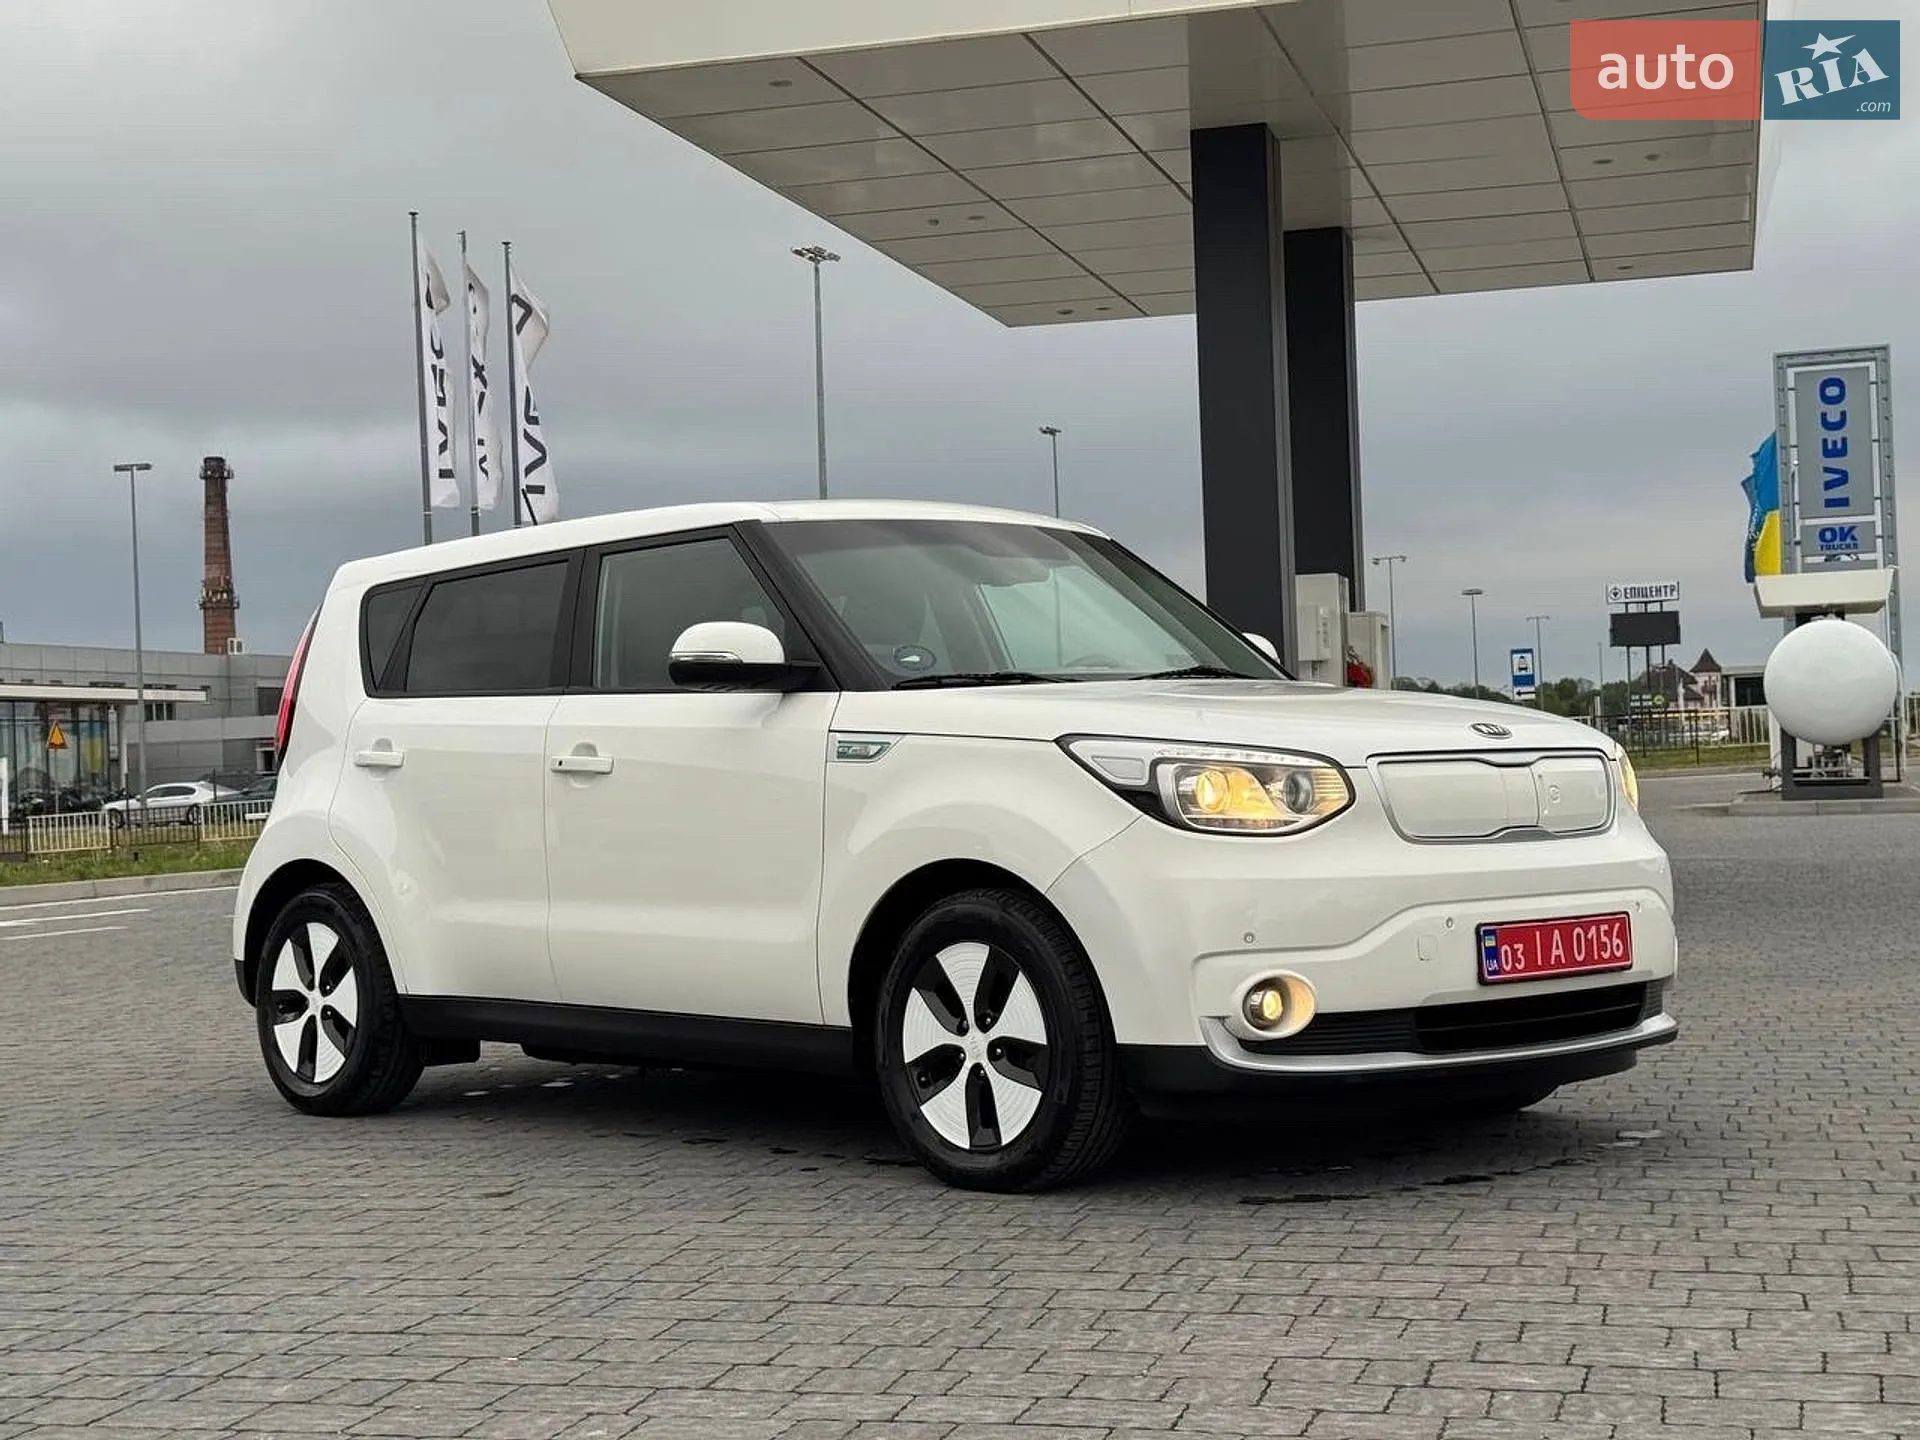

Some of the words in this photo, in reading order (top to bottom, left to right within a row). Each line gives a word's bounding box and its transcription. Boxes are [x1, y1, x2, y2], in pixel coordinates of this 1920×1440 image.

[1819, 377, 1850, 509] IVECO
[1818, 526, 1858, 543] OK
[1623, 584, 1677, 600] ЕПІЦЕНТР
[1501, 943, 1525, 971] 03
[1573, 923, 1624, 962] 0156
